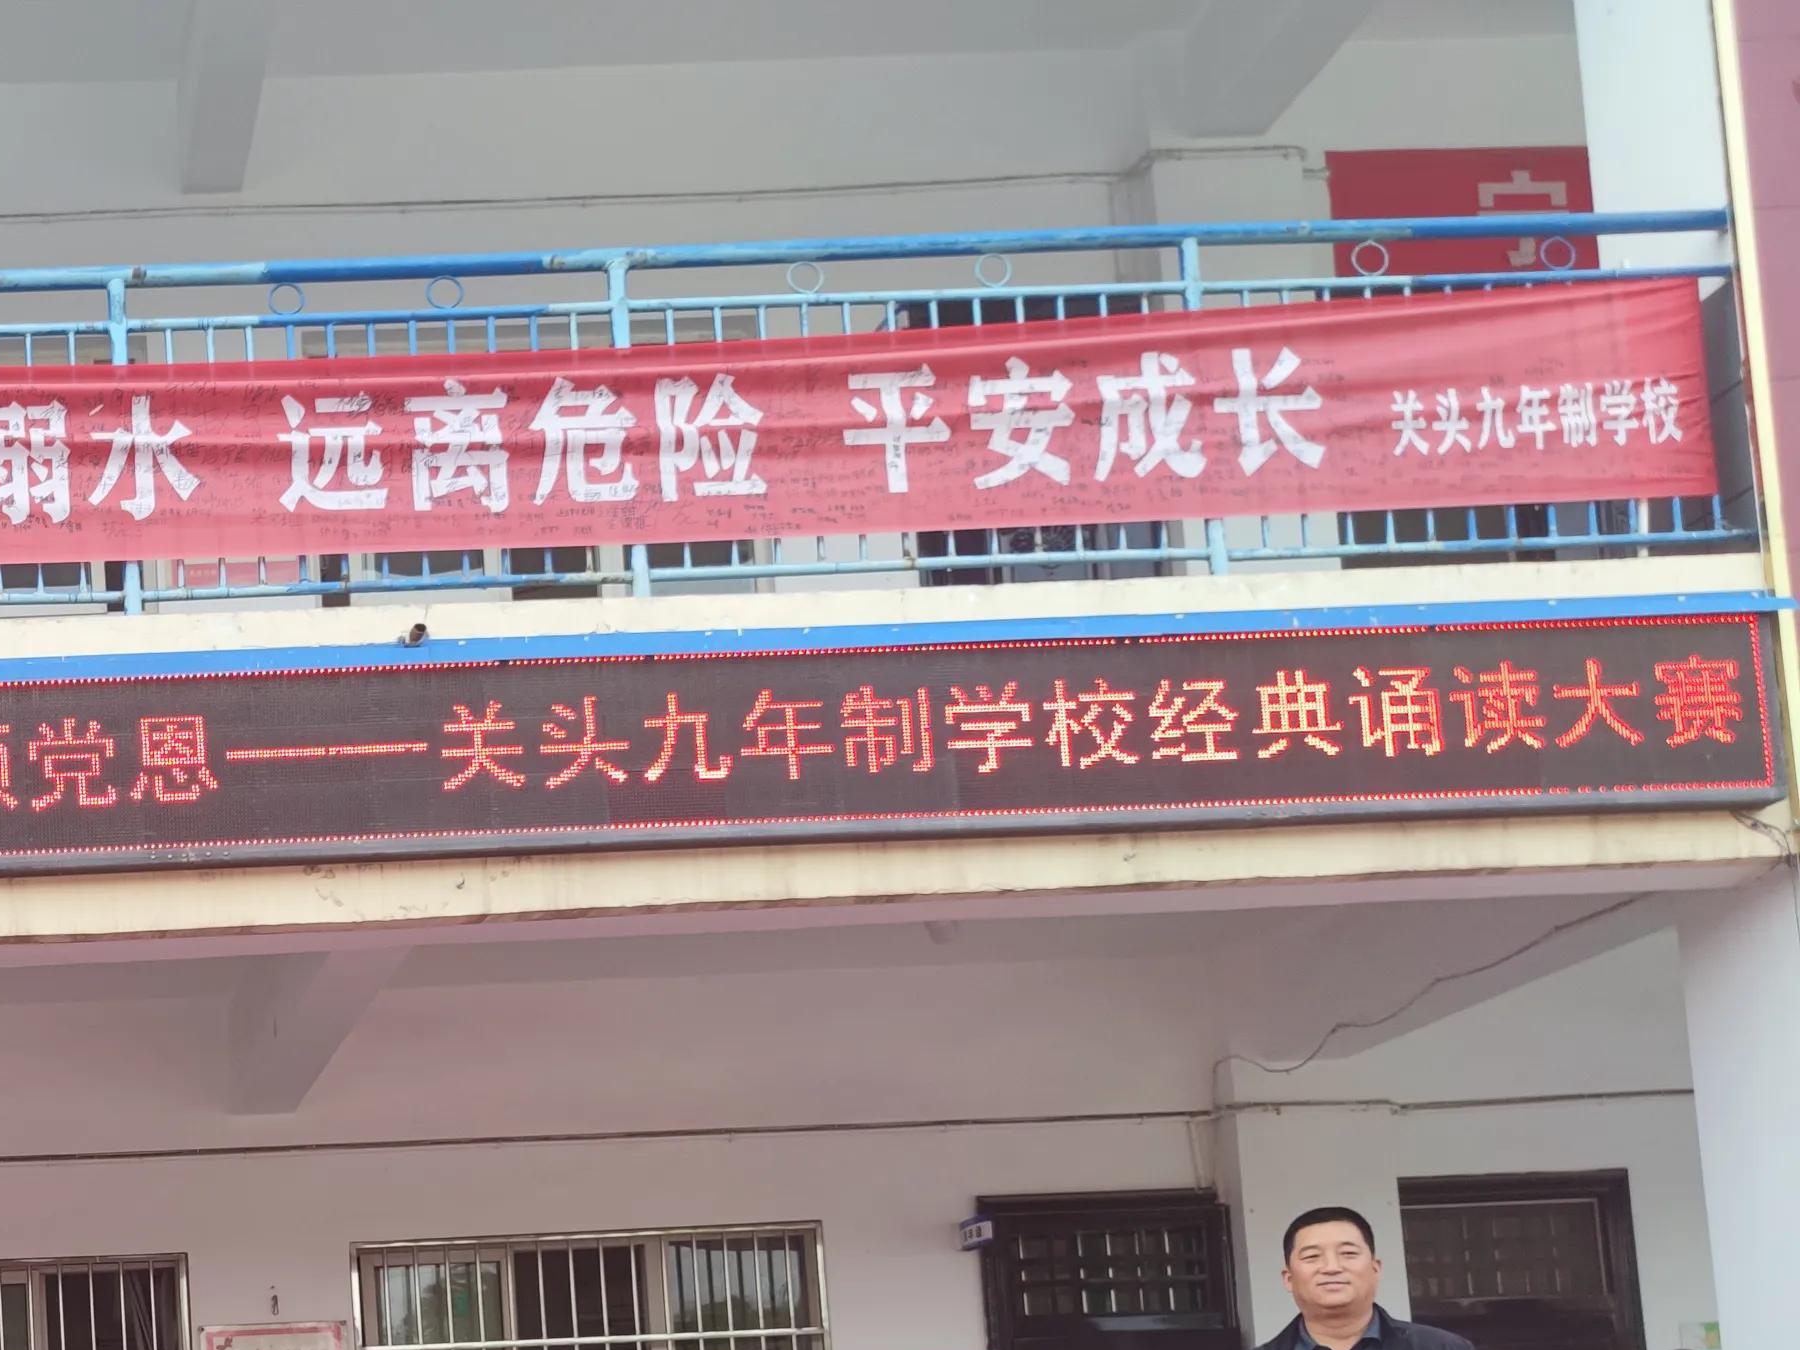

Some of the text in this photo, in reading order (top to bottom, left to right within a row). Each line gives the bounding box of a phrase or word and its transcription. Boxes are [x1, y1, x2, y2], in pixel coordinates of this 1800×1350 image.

[278, 373, 767, 513] 远离危险
[843, 345, 1325, 494] 平安成长
[1390, 375, 1685, 457] 关头九年制学校
